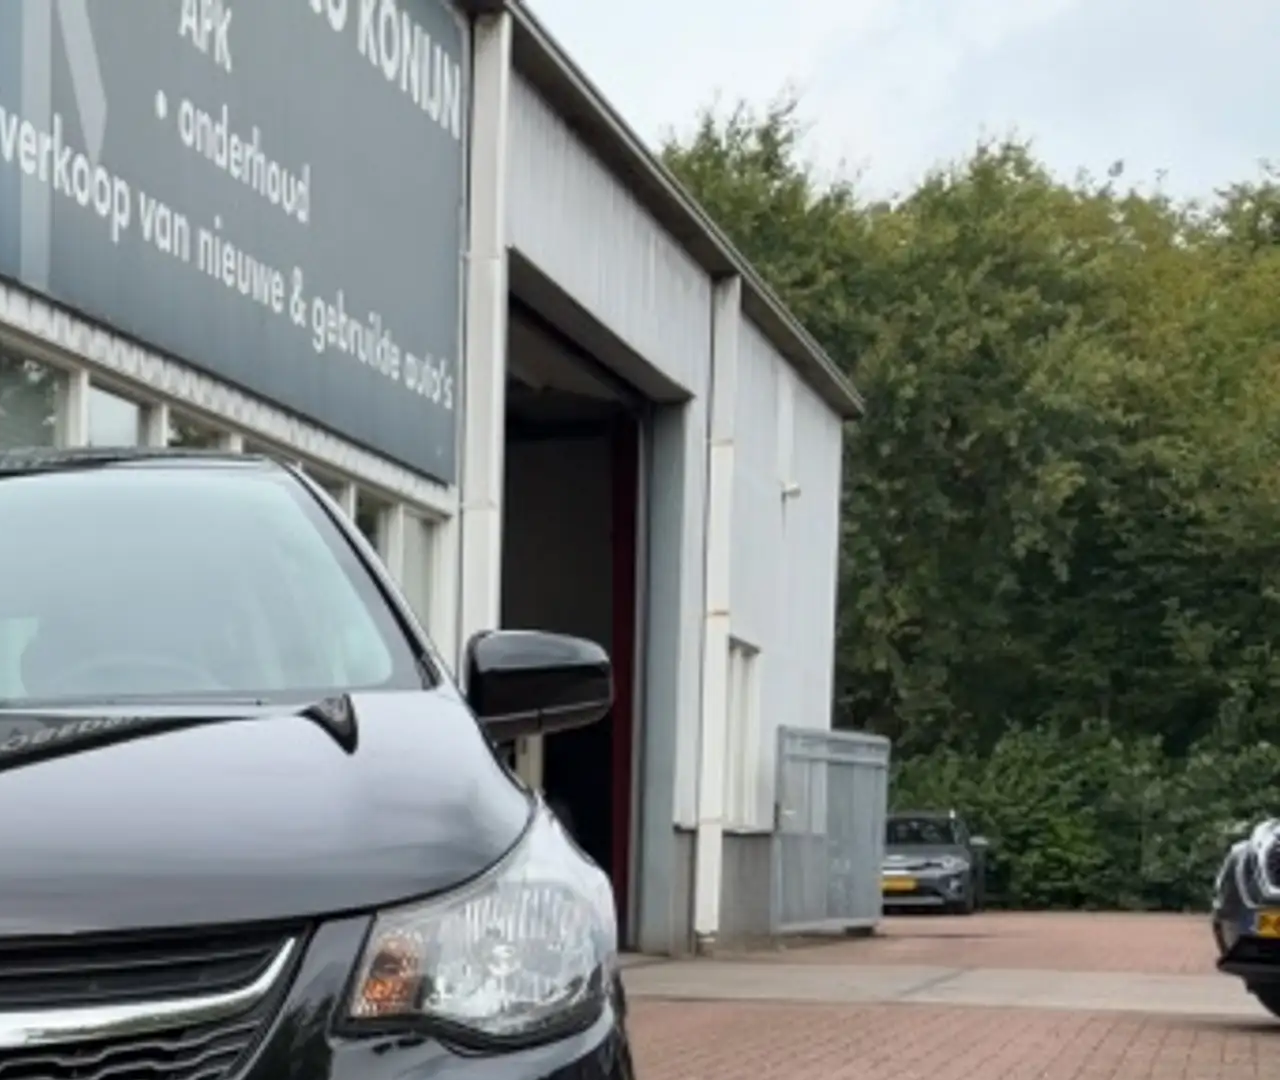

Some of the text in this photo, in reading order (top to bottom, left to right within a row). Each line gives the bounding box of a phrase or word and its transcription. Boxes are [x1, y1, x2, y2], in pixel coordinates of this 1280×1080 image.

[178, 0, 232, 73] APK
[357, 0, 461, 140] KONIJN
[178, 98, 311, 224] onderhoud
[139, 191, 190, 262] van
[199, 215, 284, 313] nieuwe
[289, 266, 306, 328] &
[312, 288, 400, 380] gebruikte
